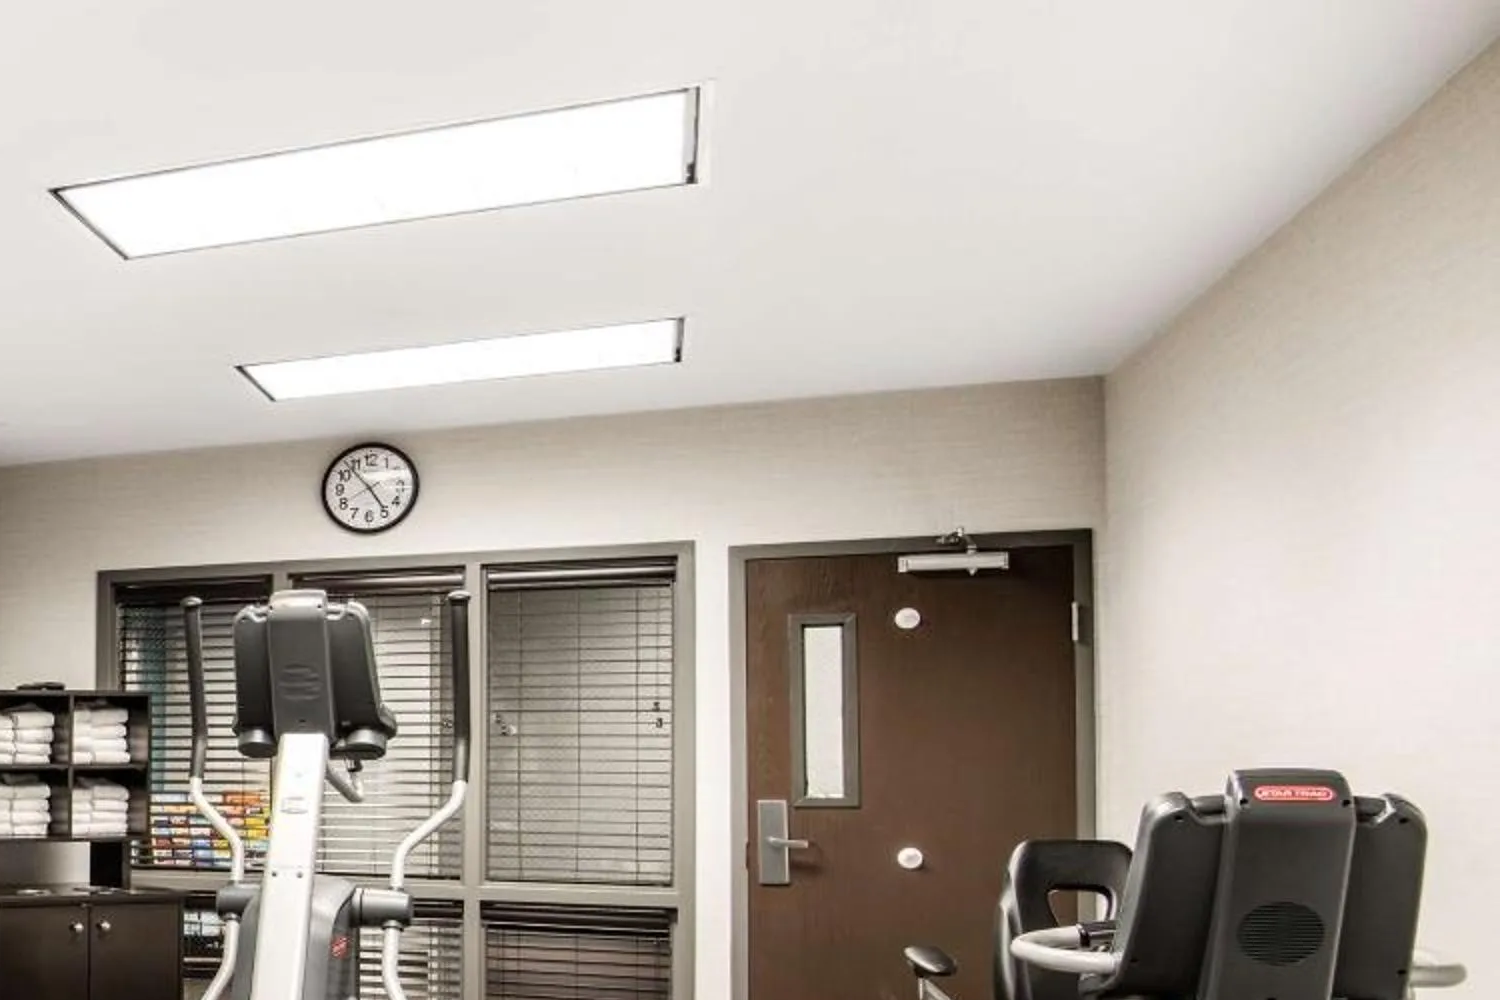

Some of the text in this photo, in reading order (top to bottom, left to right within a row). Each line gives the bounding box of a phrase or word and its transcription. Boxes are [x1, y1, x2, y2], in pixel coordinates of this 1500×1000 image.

[364, 453, 378, 466] 12
[384, 456, 389, 469] 1
[338, 469, 351, 482] 10
[335, 483, 345, 496] 9
[339, 497, 349, 510] 8
[391, 495, 401, 507] 4
[350, 507, 359, 519] 7
[364, 510, 374, 523] 6
[380, 505, 389, 518] 5
